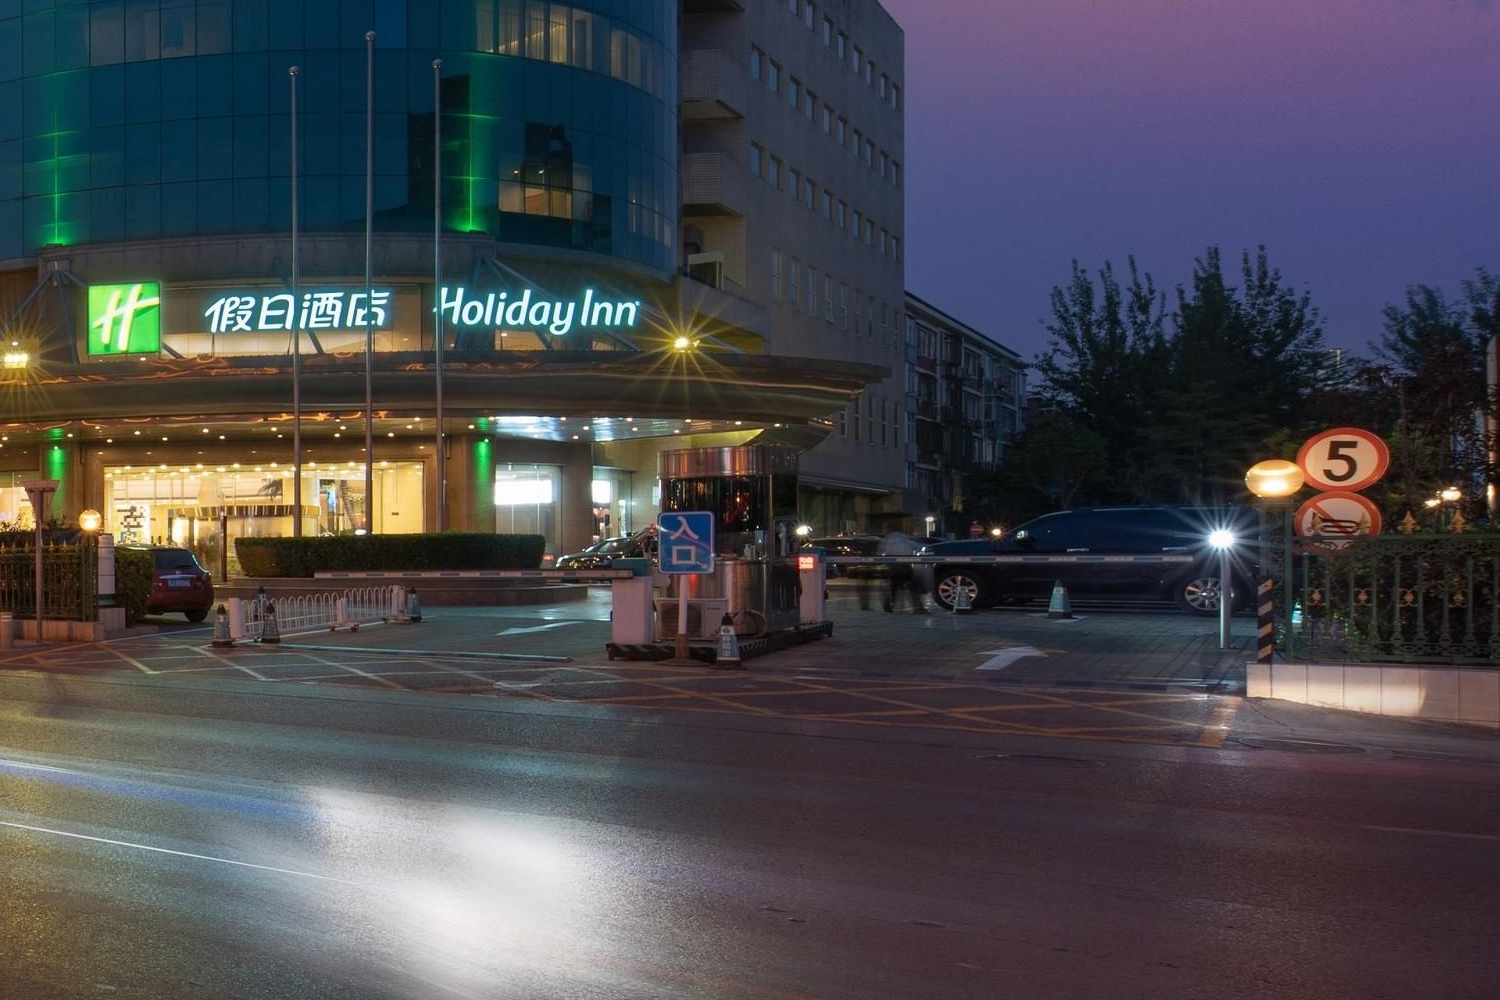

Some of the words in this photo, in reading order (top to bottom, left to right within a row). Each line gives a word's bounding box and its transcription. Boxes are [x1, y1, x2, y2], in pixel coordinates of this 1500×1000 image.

[205, 290, 390, 333] 假日酒店
[433, 287, 575, 336] Holiday
[581, 289, 638, 326] Inn
[1322, 440, 1358, 482] 5
[670, 515, 700, 565] 入口
